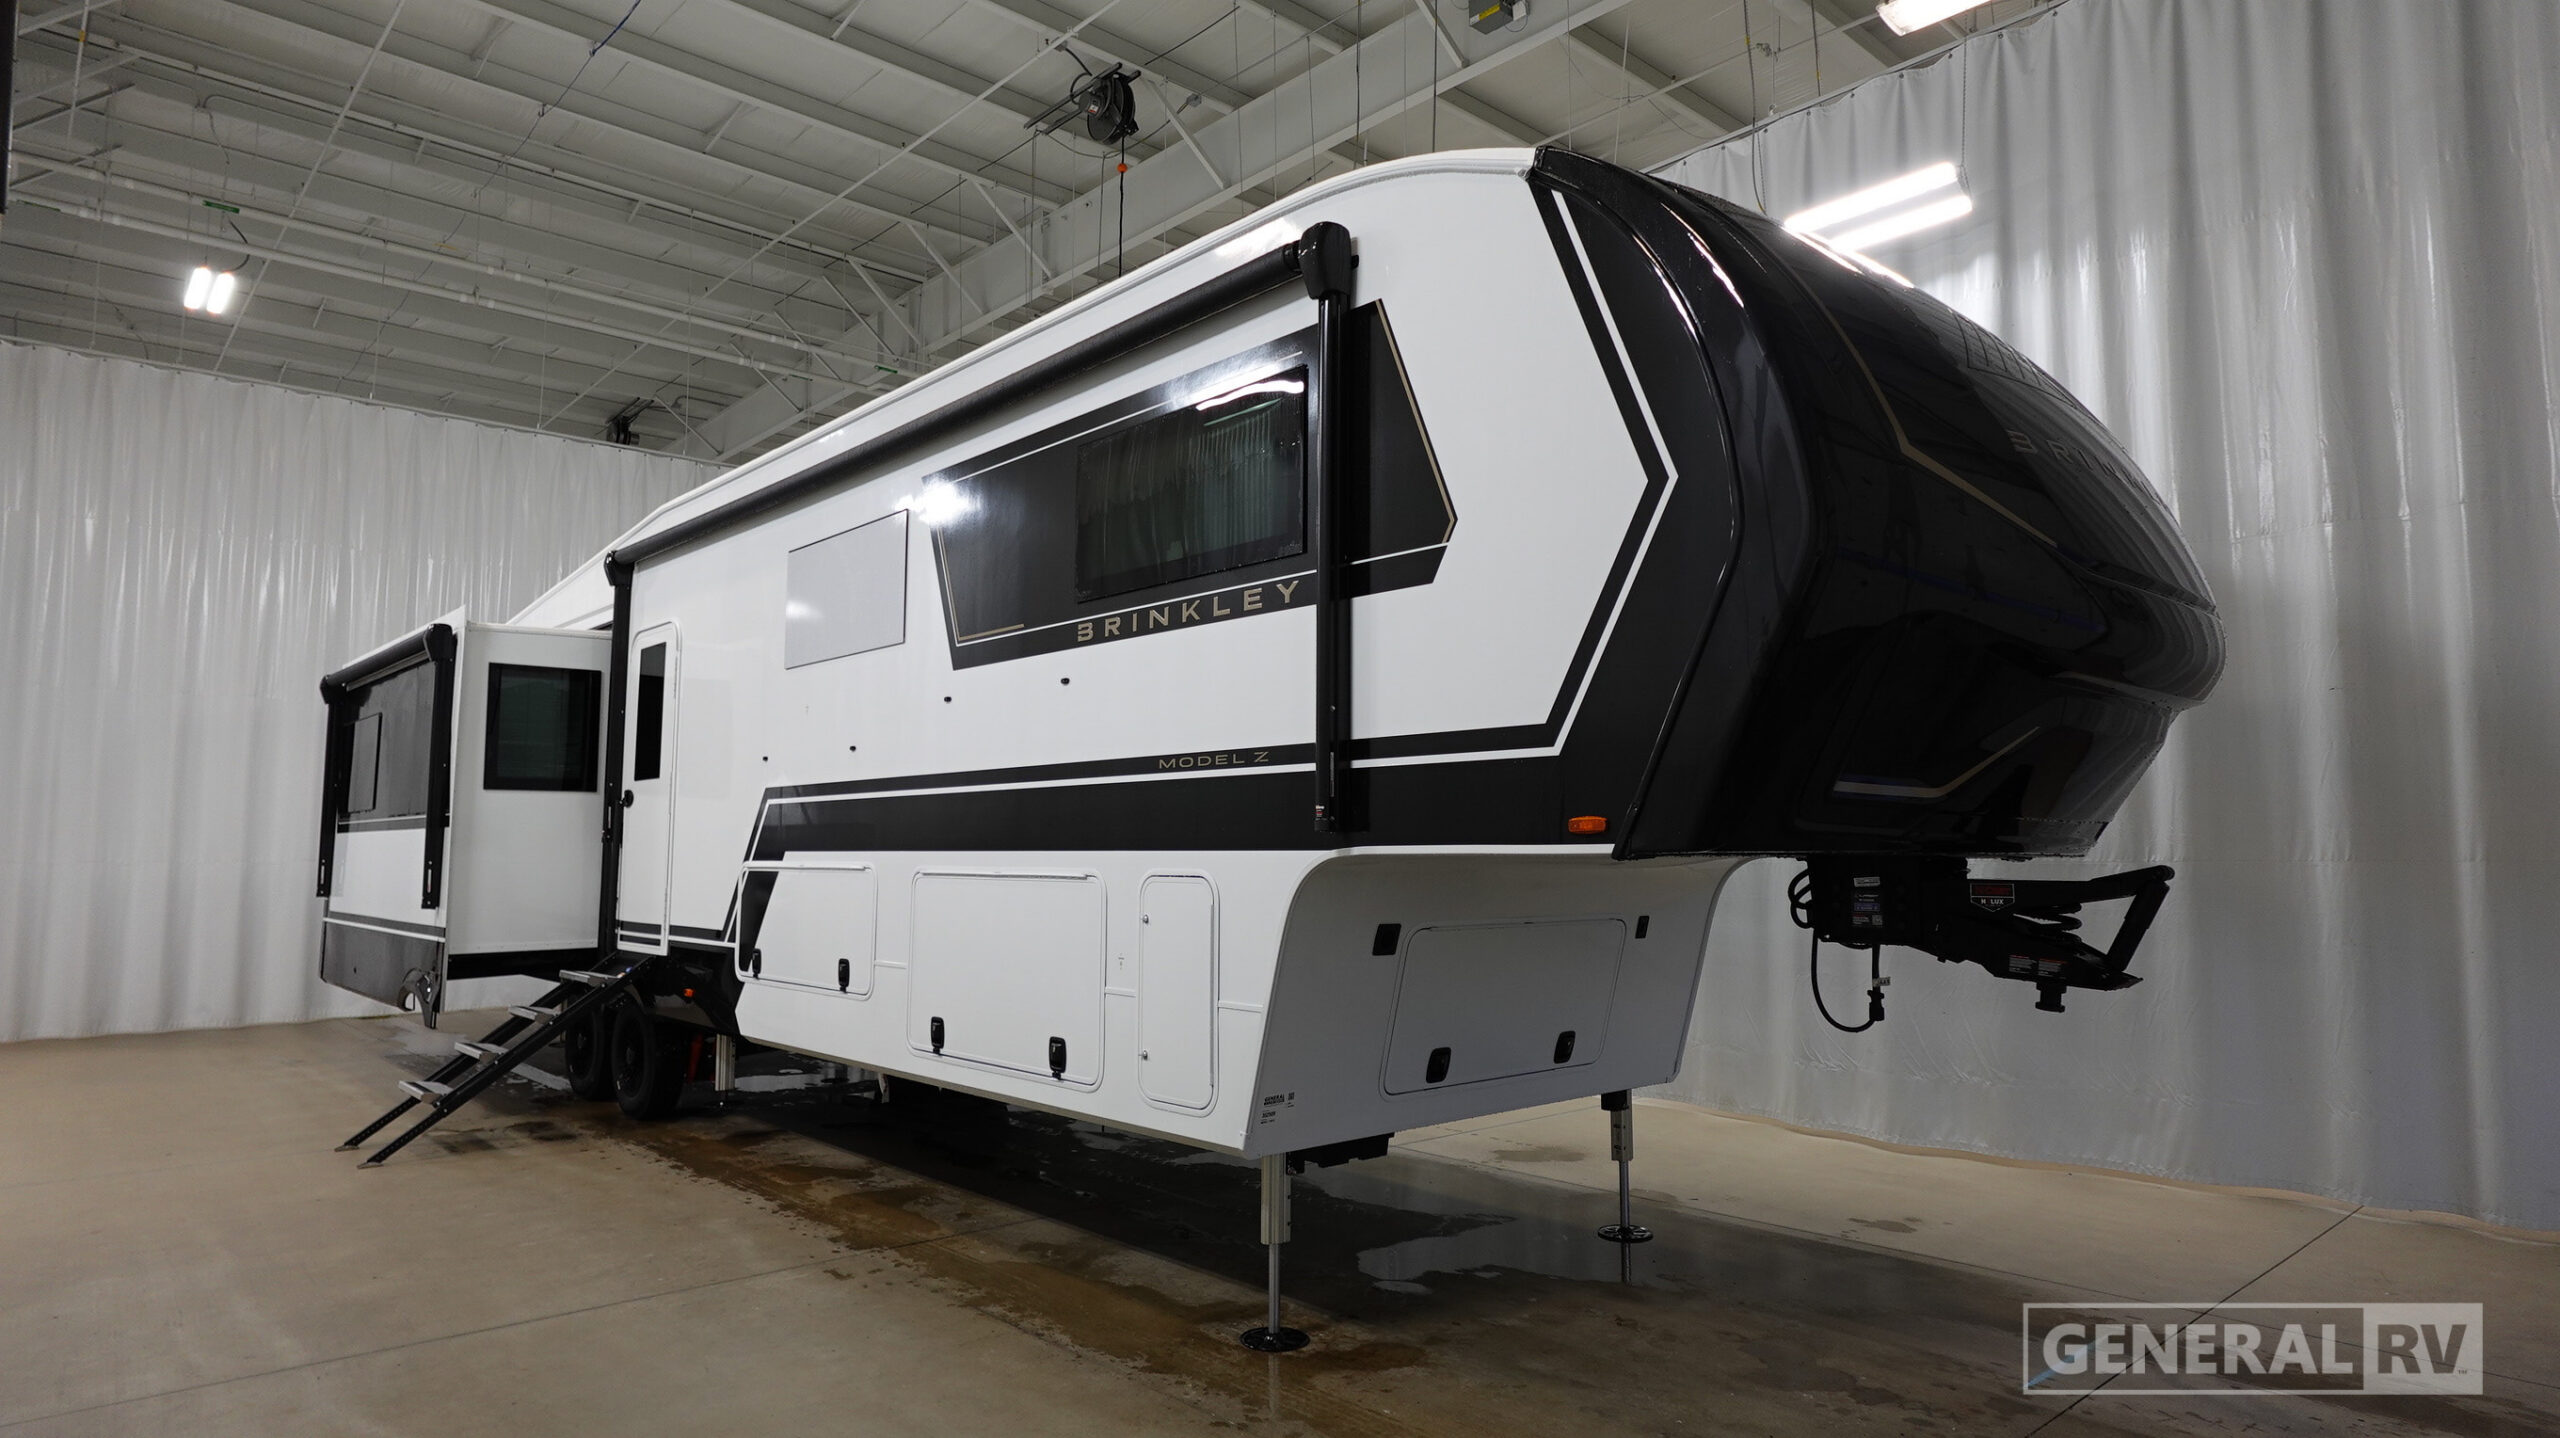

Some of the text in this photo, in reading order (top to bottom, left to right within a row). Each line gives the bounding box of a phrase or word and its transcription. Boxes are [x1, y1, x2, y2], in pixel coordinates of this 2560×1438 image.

[2007, 430, 2168, 512] BRINKL
[1076, 580, 1299, 642] BRINKLEY
[1158, 751, 1269, 769] MODEL Z
